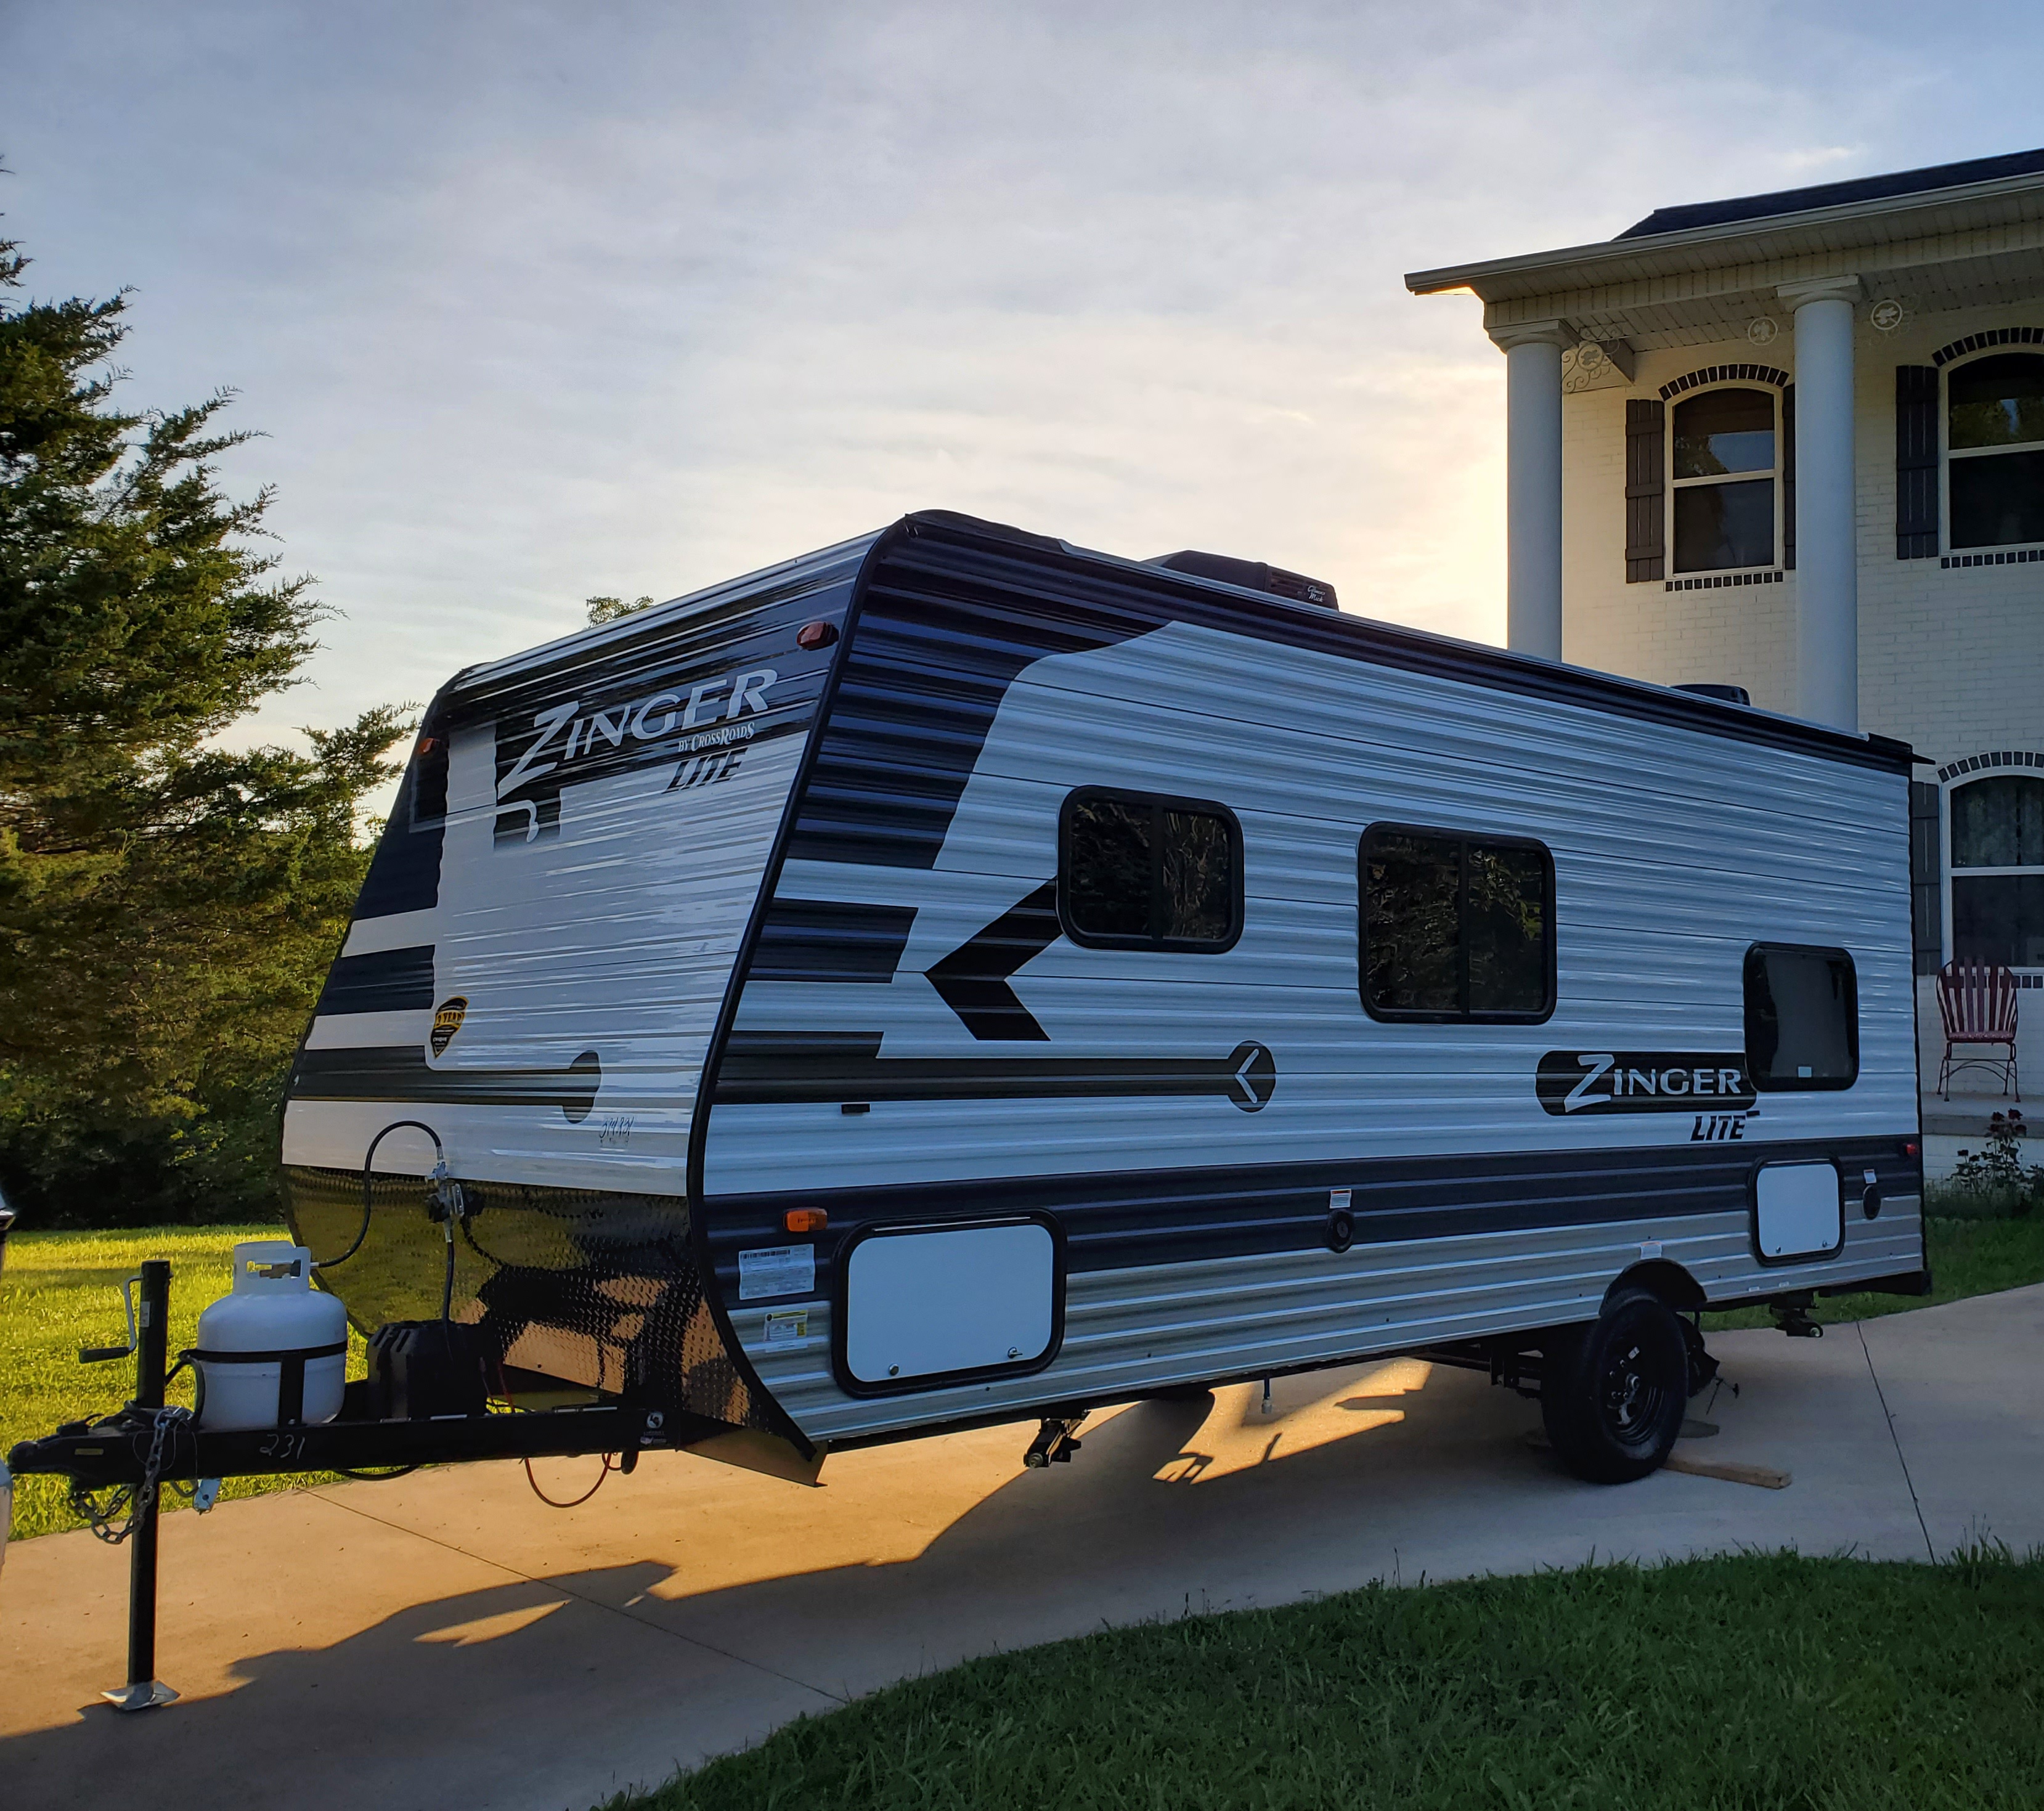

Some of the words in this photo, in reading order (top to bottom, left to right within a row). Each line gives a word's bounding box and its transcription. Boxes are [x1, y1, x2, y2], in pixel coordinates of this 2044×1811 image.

[497, 669, 778, 800] ZINGER
[678, 739, 691, 752] BY
[661, 747, 749, 794] LITE
[1563, 1054, 1742, 1113] ZINGER
[1690, 1115, 1746, 1141] LITE
[259, 1433, 306, 1460] 231
